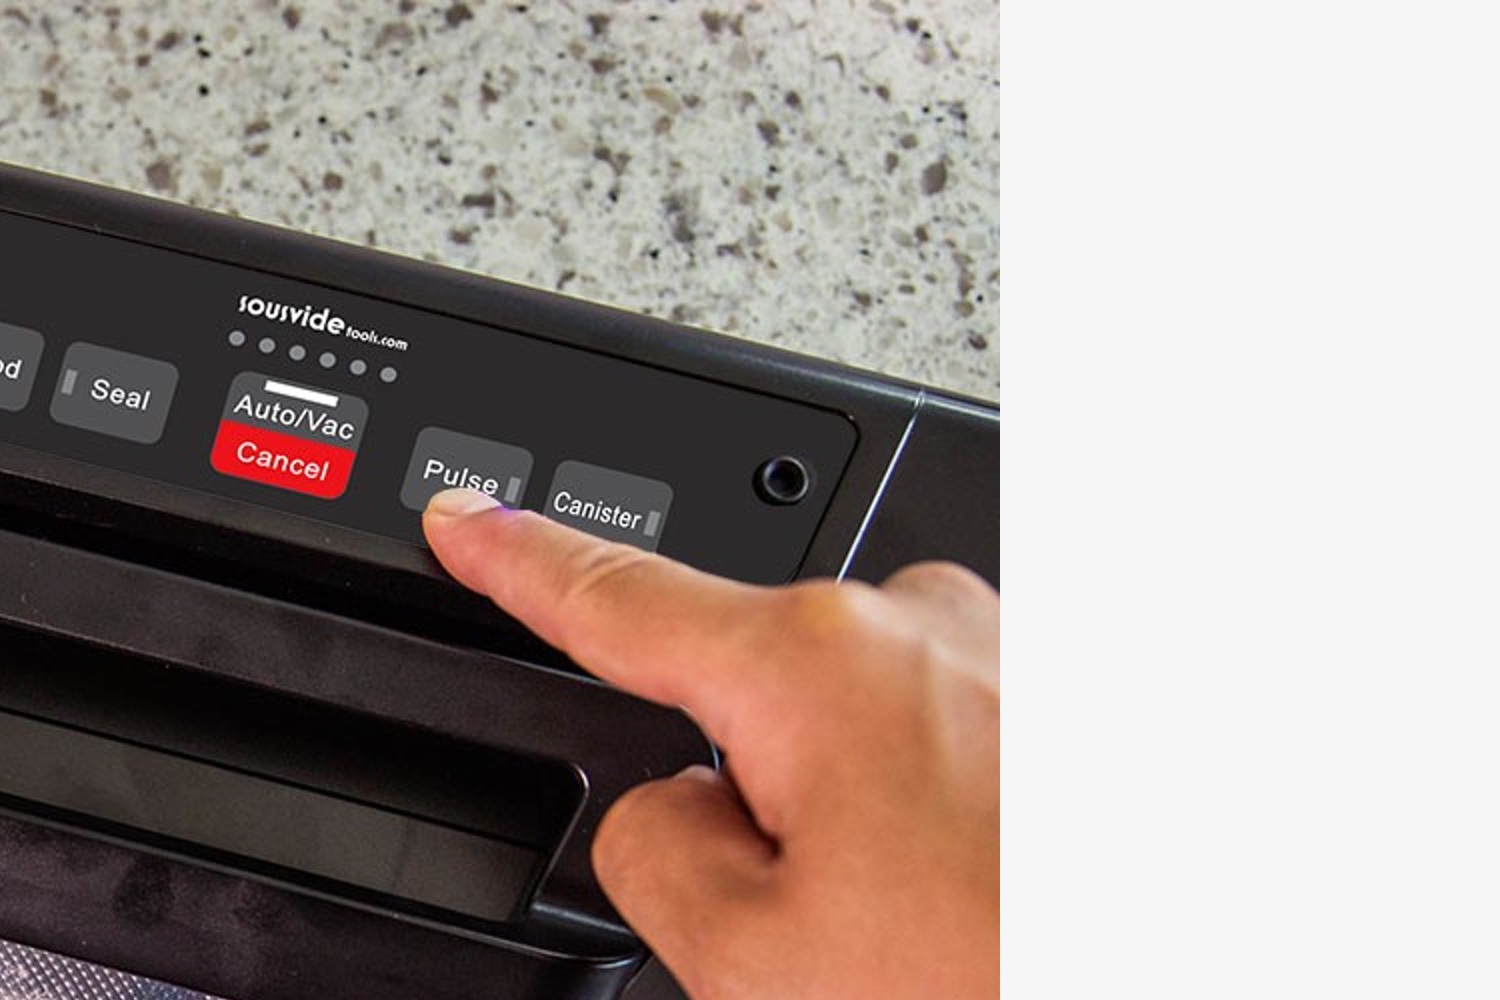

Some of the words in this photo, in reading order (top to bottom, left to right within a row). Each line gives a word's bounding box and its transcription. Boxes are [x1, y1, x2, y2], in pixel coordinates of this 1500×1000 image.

[91, 378, 151, 411] Seal
[233, 394, 355, 440] Auto/Vac
[237, 441, 329, 481] Cancel
[423, 459, 499, 496] Pulse
[553, 491, 642, 529] Canister
